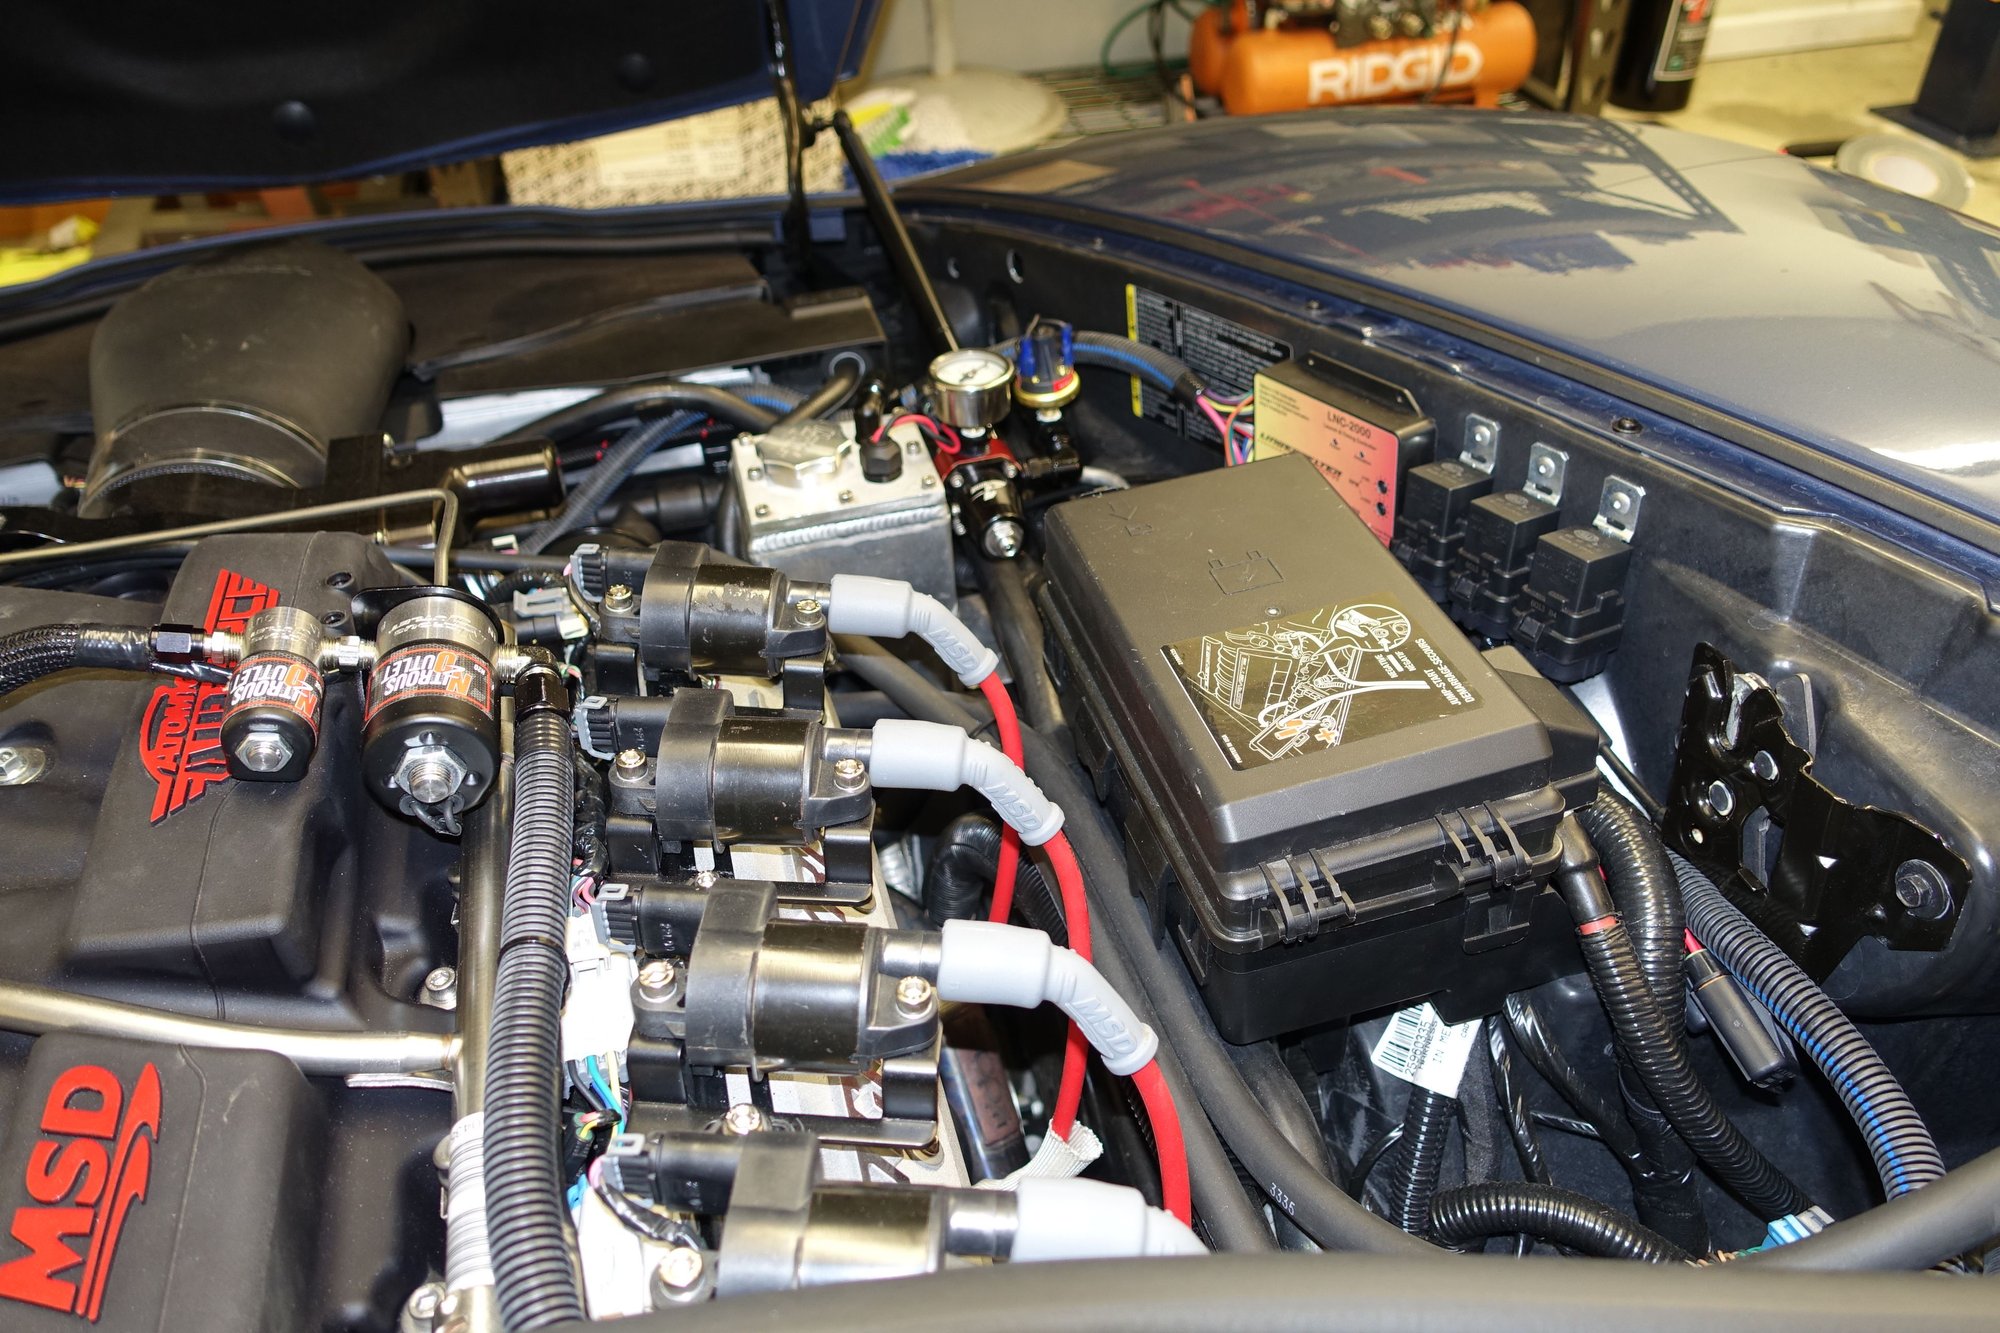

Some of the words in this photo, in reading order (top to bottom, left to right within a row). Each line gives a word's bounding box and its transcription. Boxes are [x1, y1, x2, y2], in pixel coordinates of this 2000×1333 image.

[1309, 41, 1483, 103] RIDGID
[1326, 411, 1371, 439] LNC-2000
[381, 650, 458, 685] OUTLET
[928, 628, 980, 672] MSD
[1374, 654, 1398, 679] NEGATIVE
[200, 663, 311, 694] OUTLET
[383, 669, 473, 696] NITROUS
[1424, 669, 1461, 706] JUMP-START
[201, 679, 318, 718] NITROUS
[985, 782, 1043, 831] MSD
[1072, 996, 1137, 1054] MSD
[1404, 1021, 1430, 1077] 25960335
[1417, 1020, 1438, 1070] HARNESS
[1432, 1049, 1445, 1064] IN
[1439, 1027, 1452, 1043] ME
[0, 1064, 122, 1312] MSD
[1270, 1182, 1296, 1216] 3335
